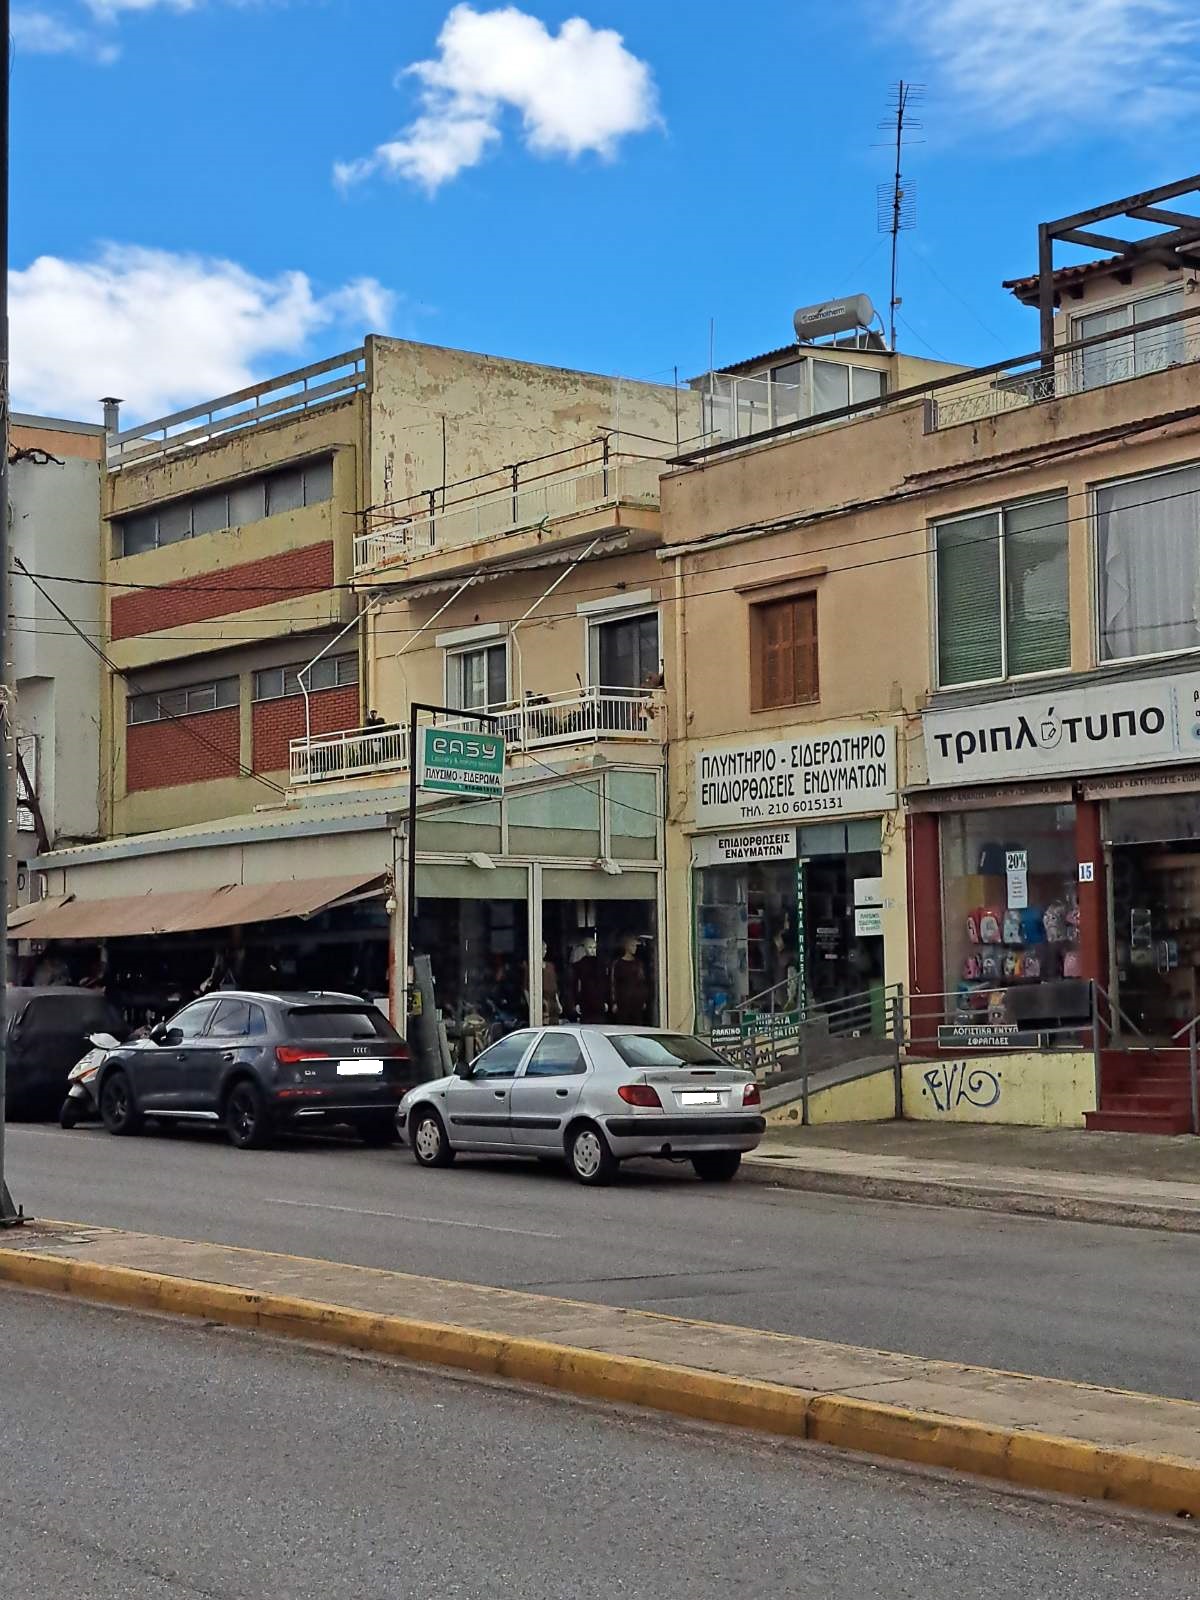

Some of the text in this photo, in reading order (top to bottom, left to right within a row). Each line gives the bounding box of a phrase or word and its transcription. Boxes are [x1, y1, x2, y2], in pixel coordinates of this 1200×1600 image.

[702, 749, 776, 779] ΠΛΥΝΤΗΡΙΟ
[791, 734, 886, 768] ΣΙΔΕΡΩΤΗΡΙΟ
[426, 768, 458, 781] ΠΛΥΣΙΜΟ
[463, 771, 500, 785] ΣΙΔΕΡΩΜΑ
[702, 763, 887, 805] ΕΠΙΔΙΟΡΘΩΣΕΙΣ ΕΝΔΥΜΑΤΩΝ
[741, 797, 843, 818] ΤΗΛ. 210 6015131
[718, 833, 790, 849] ΕΠΙΔΙΟΡΘΩΣΕΙΣ
[725, 845, 783, 859] ΕΝΔΥΜΑΤΩΝ
[1007, 854, 1026, 870] 20%
[1080, 865, 1092, 879] 15
